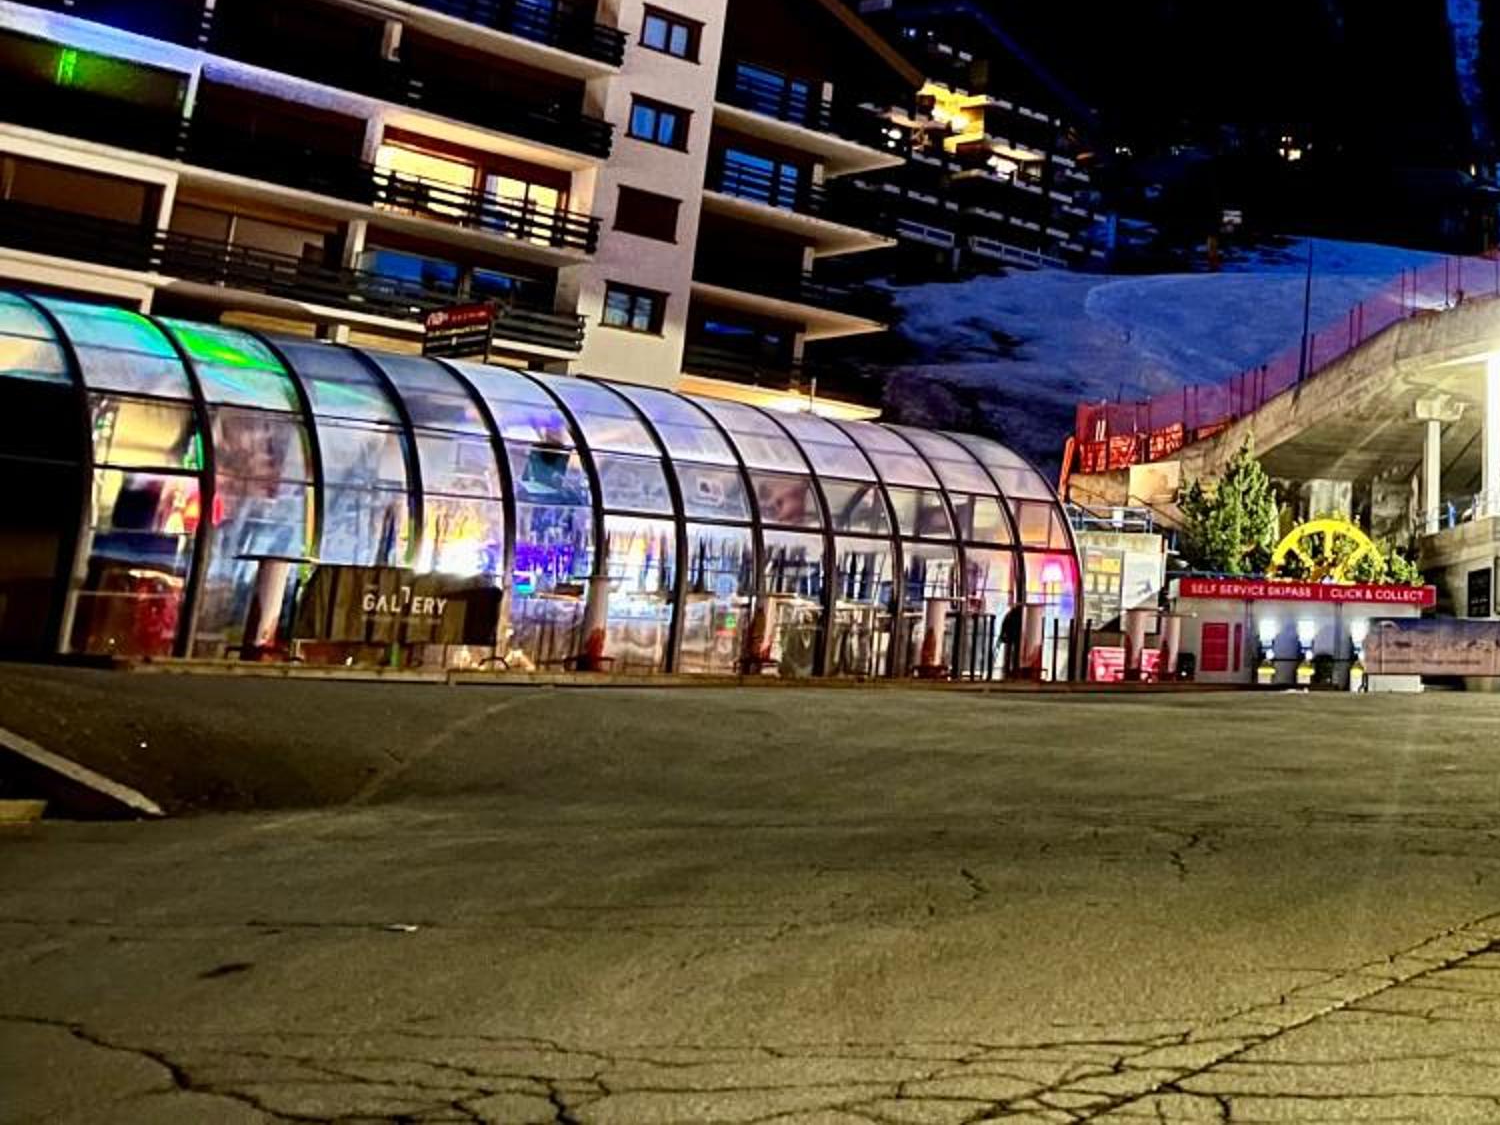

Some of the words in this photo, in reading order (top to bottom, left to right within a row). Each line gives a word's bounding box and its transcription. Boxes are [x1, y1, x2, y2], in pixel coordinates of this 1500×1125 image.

[1191, 583, 1217, 594] SELF
[1219, 584, 1264, 596] SERVICE
[1267, 586, 1312, 598] SKIPASS
[1330, 586, 1363, 600] CLICK
[1364, 589, 1373, 600] &
[1375, 589, 1424, 602] COLLECT
